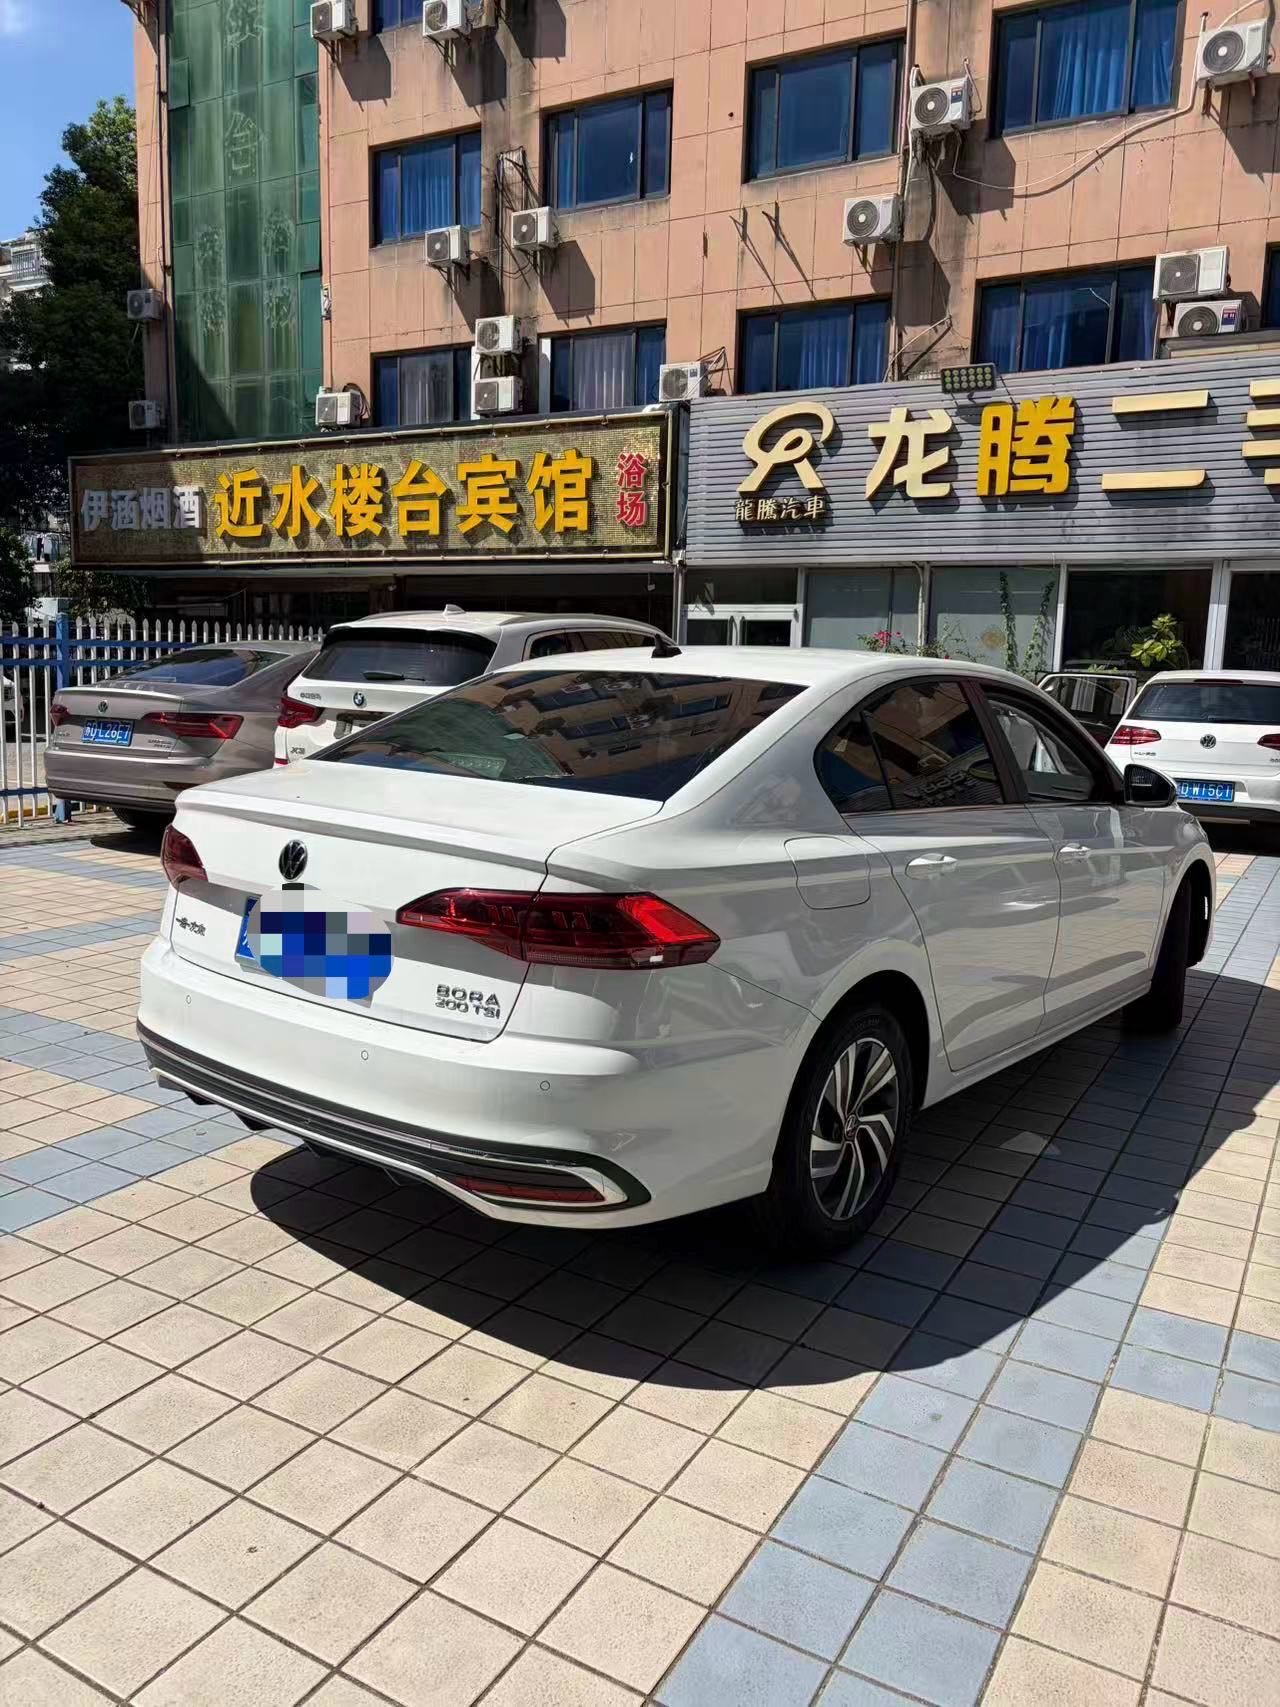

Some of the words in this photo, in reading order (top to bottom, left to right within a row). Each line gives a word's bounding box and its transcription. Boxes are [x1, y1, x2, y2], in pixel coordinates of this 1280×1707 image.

[214, 450, 593, 538] 近水楼台宾馆
[615, 453, 649, 528] 浴场
[735, 495, 825, 520] 龍騰汽車
[80, 486, 201, 531] 伊涵烟酒
[436, 984, 500, 1008] BORA
[472, 1003, 500, 1020] TSI
